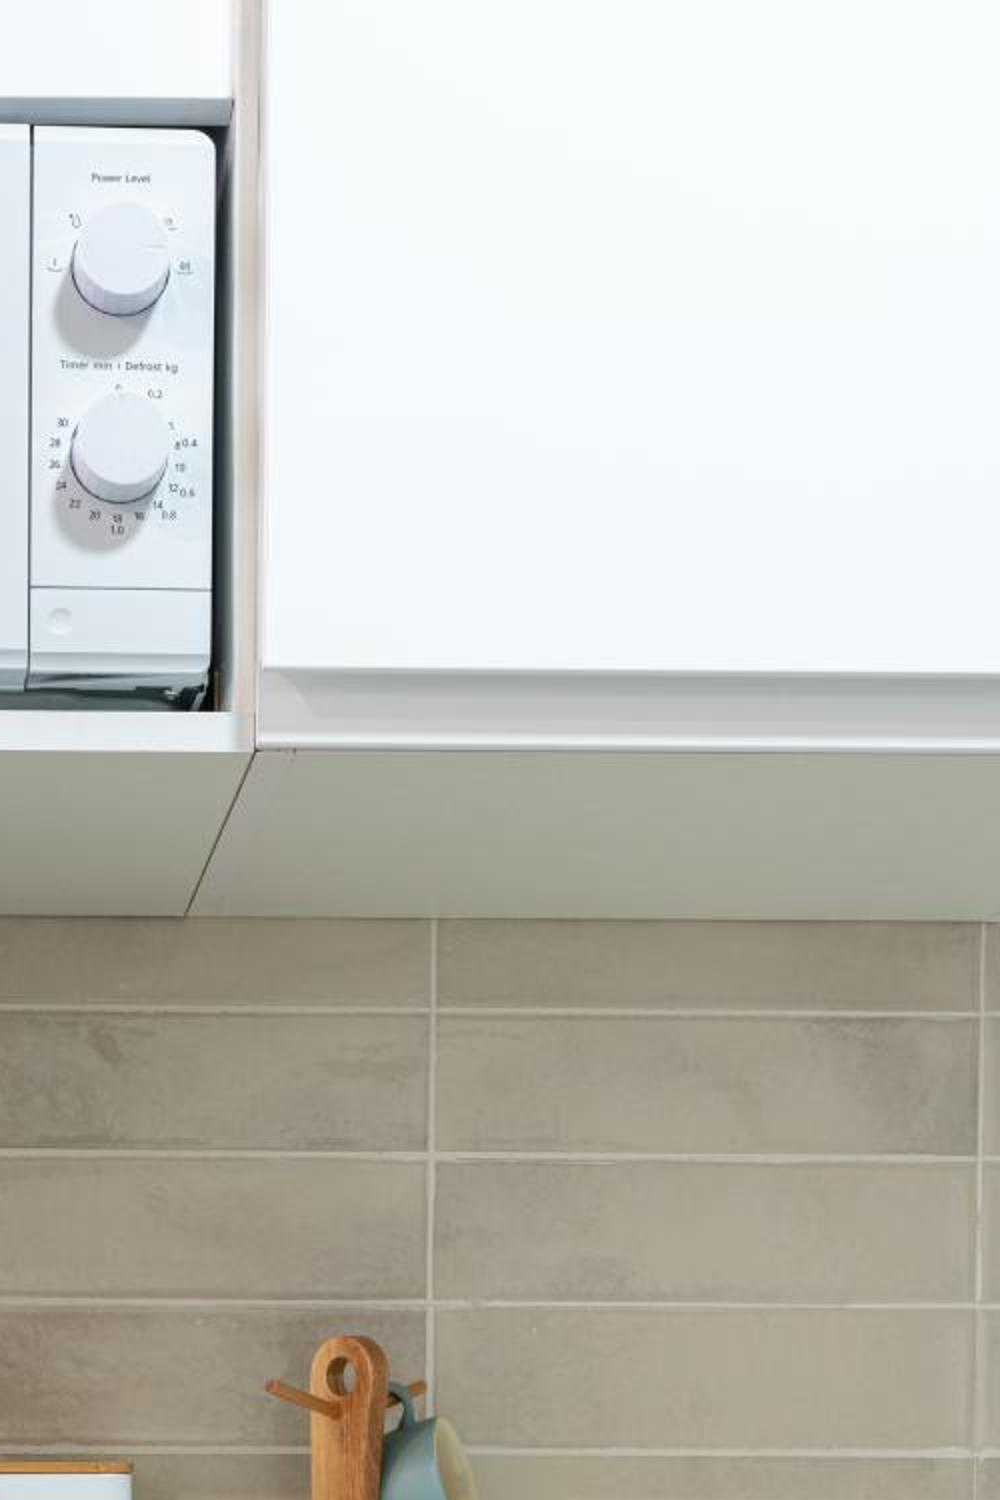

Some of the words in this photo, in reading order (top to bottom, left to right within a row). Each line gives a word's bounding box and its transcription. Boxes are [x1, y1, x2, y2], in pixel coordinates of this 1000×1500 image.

[91, 172, 121, 183] Power
[125, 173, 151, 184] Level
[60, 360, 88, 370] Timer
[125, 361, 163, 372] Defrost
[165, 362, 179, 374] kg
[147, 390, 163, 399] 0.2
